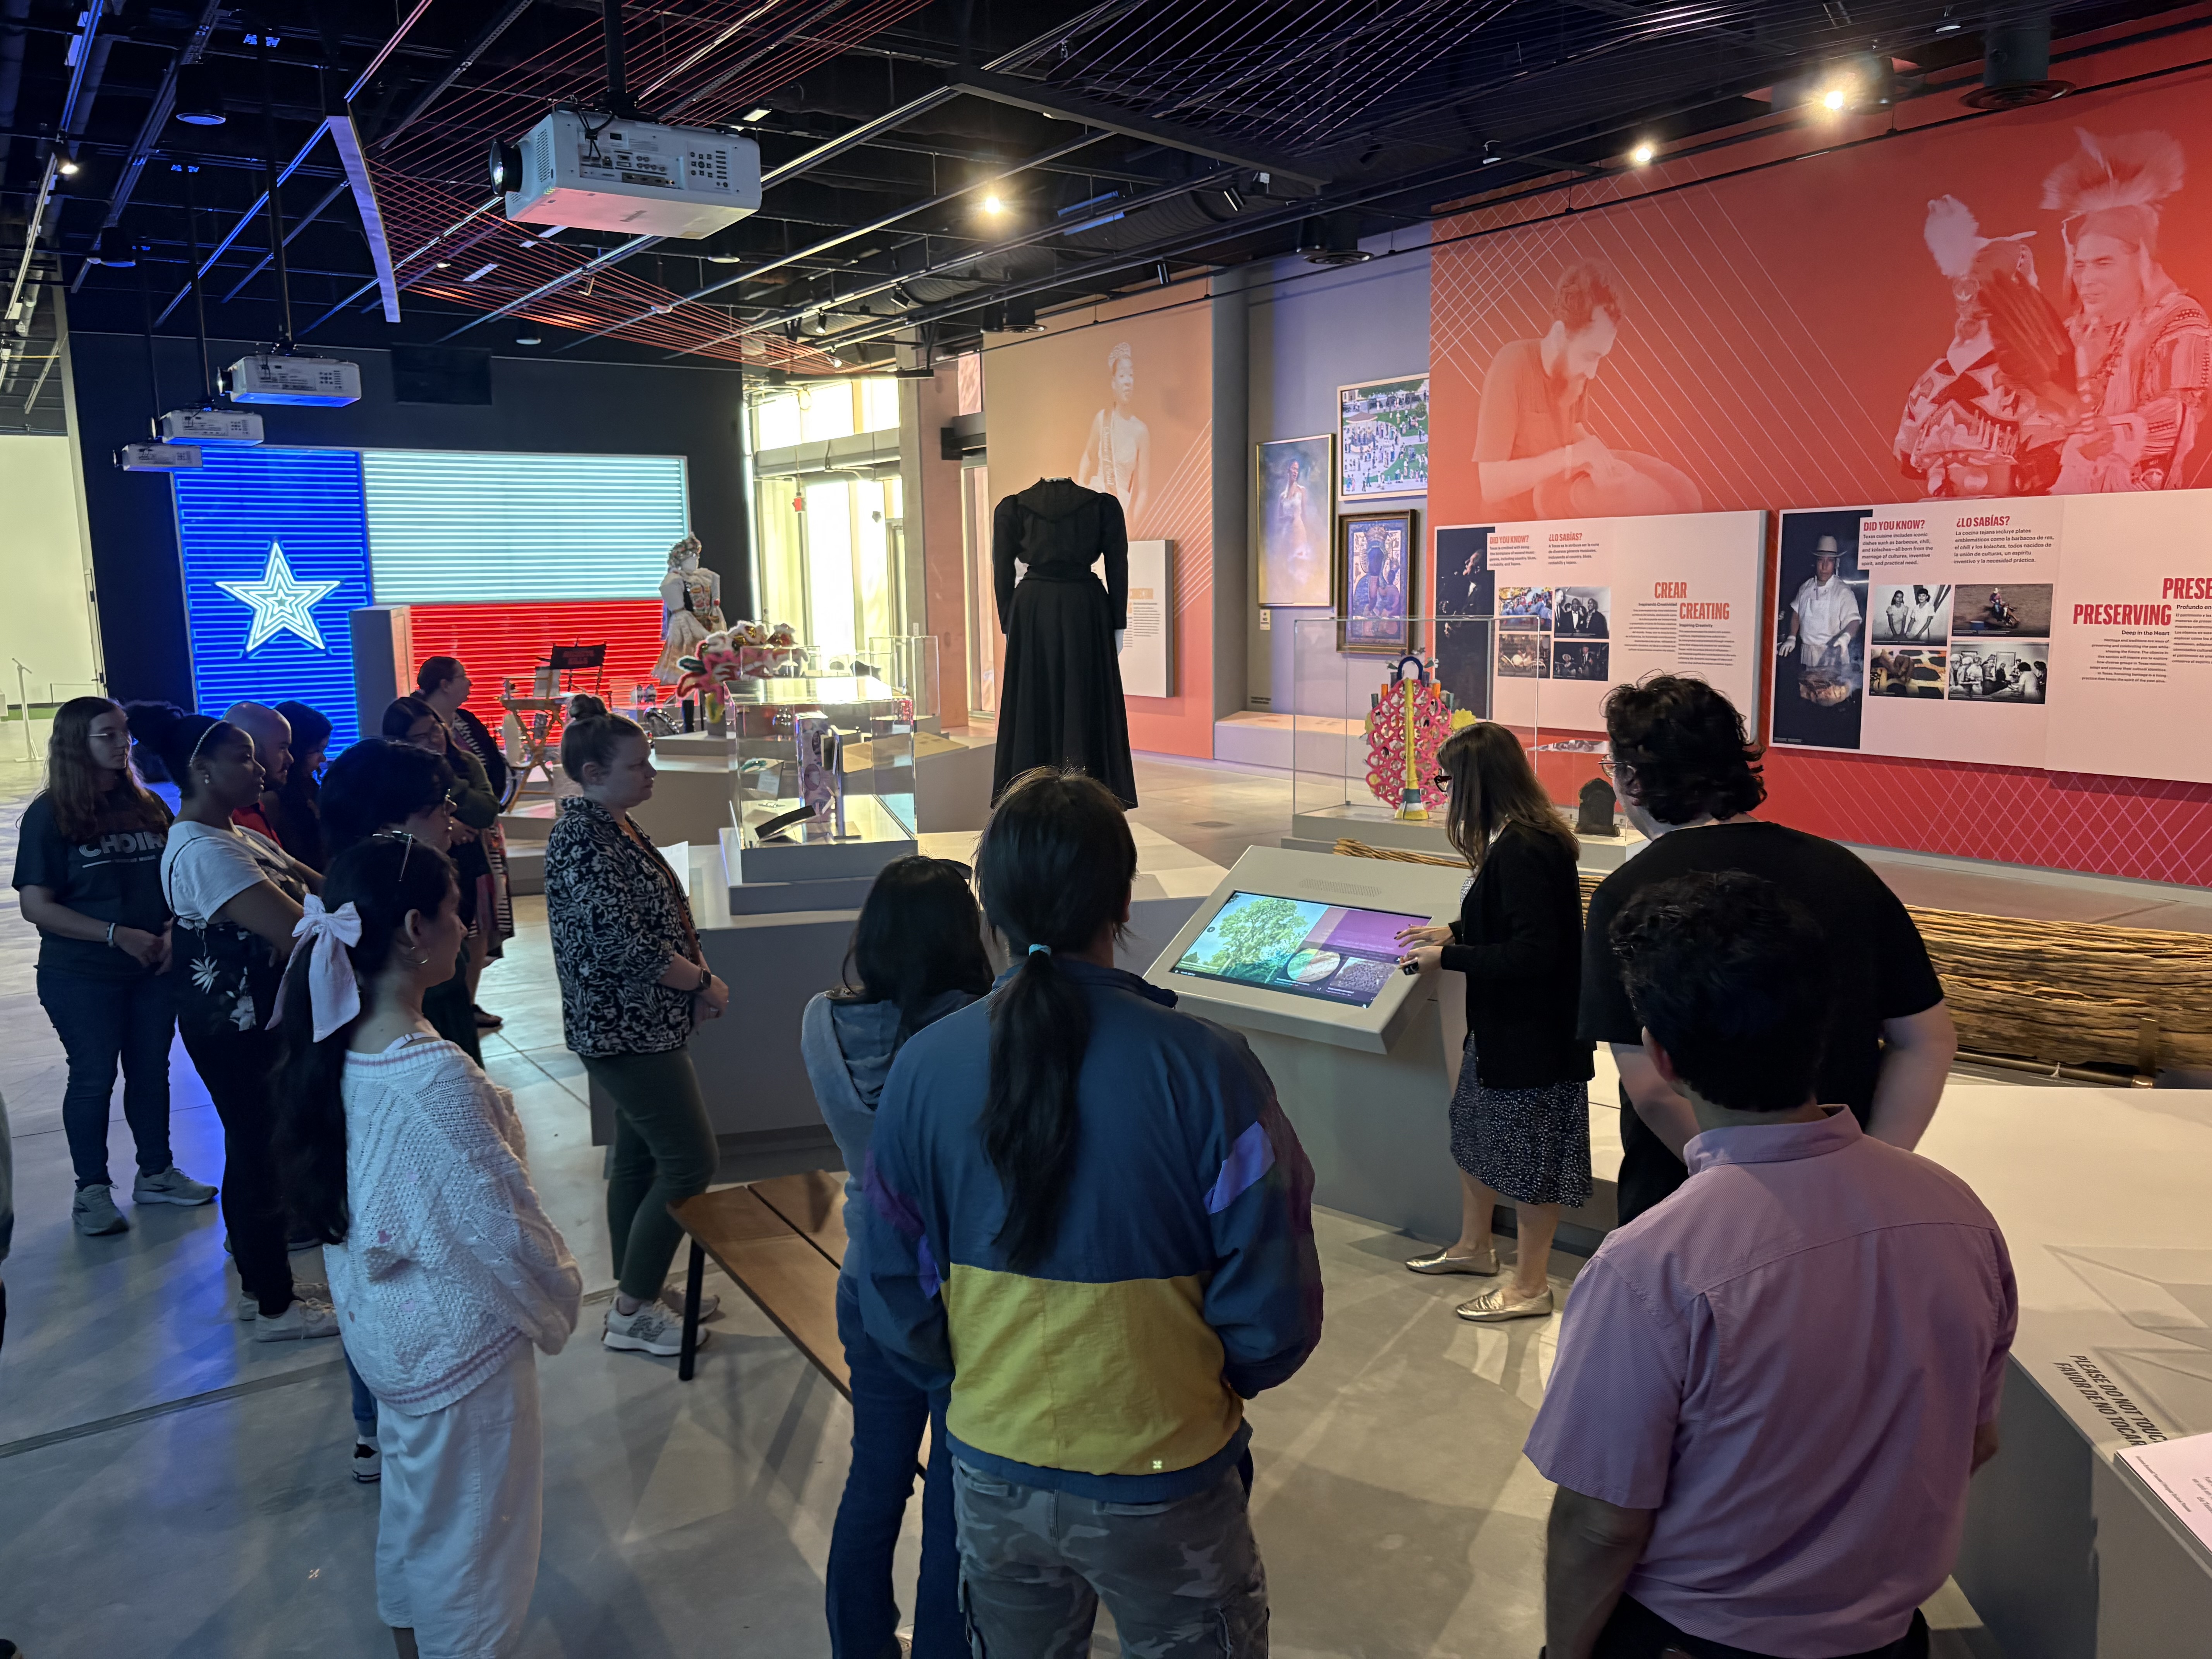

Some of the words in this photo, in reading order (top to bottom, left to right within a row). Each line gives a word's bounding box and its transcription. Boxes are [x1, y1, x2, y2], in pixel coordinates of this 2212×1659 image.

[1863, 522, 1877, 531] DID
[1879, 521, 1895, 531] YOU
[1896, 520, 1925, 530] KNOW?
[1956, 518, 1972, 527] ¿LO
[1973, 515, 2010, 527] SABÍAS?
[1559, 532, 1582, 541] SABÍAS?
[1654, 582, 1687, 598] CREAR
[1680, 603, 1730, 620] CREATING
[2073, 604, 2172, 625] PRESERVING
[2053, 1363, 2091, 1388] FAVOR
[2069, 1355, 2112, 1383] PLEASE
[2098, 1385, 2124, 1396] DO
[2112, 1398, 2143, 1415] NOT
[2080, 1390, 2105, 1401] DE
[2092, 1402, 2117, 1414] NO
[2106, 1417, 2147, 1445] TOCAR
